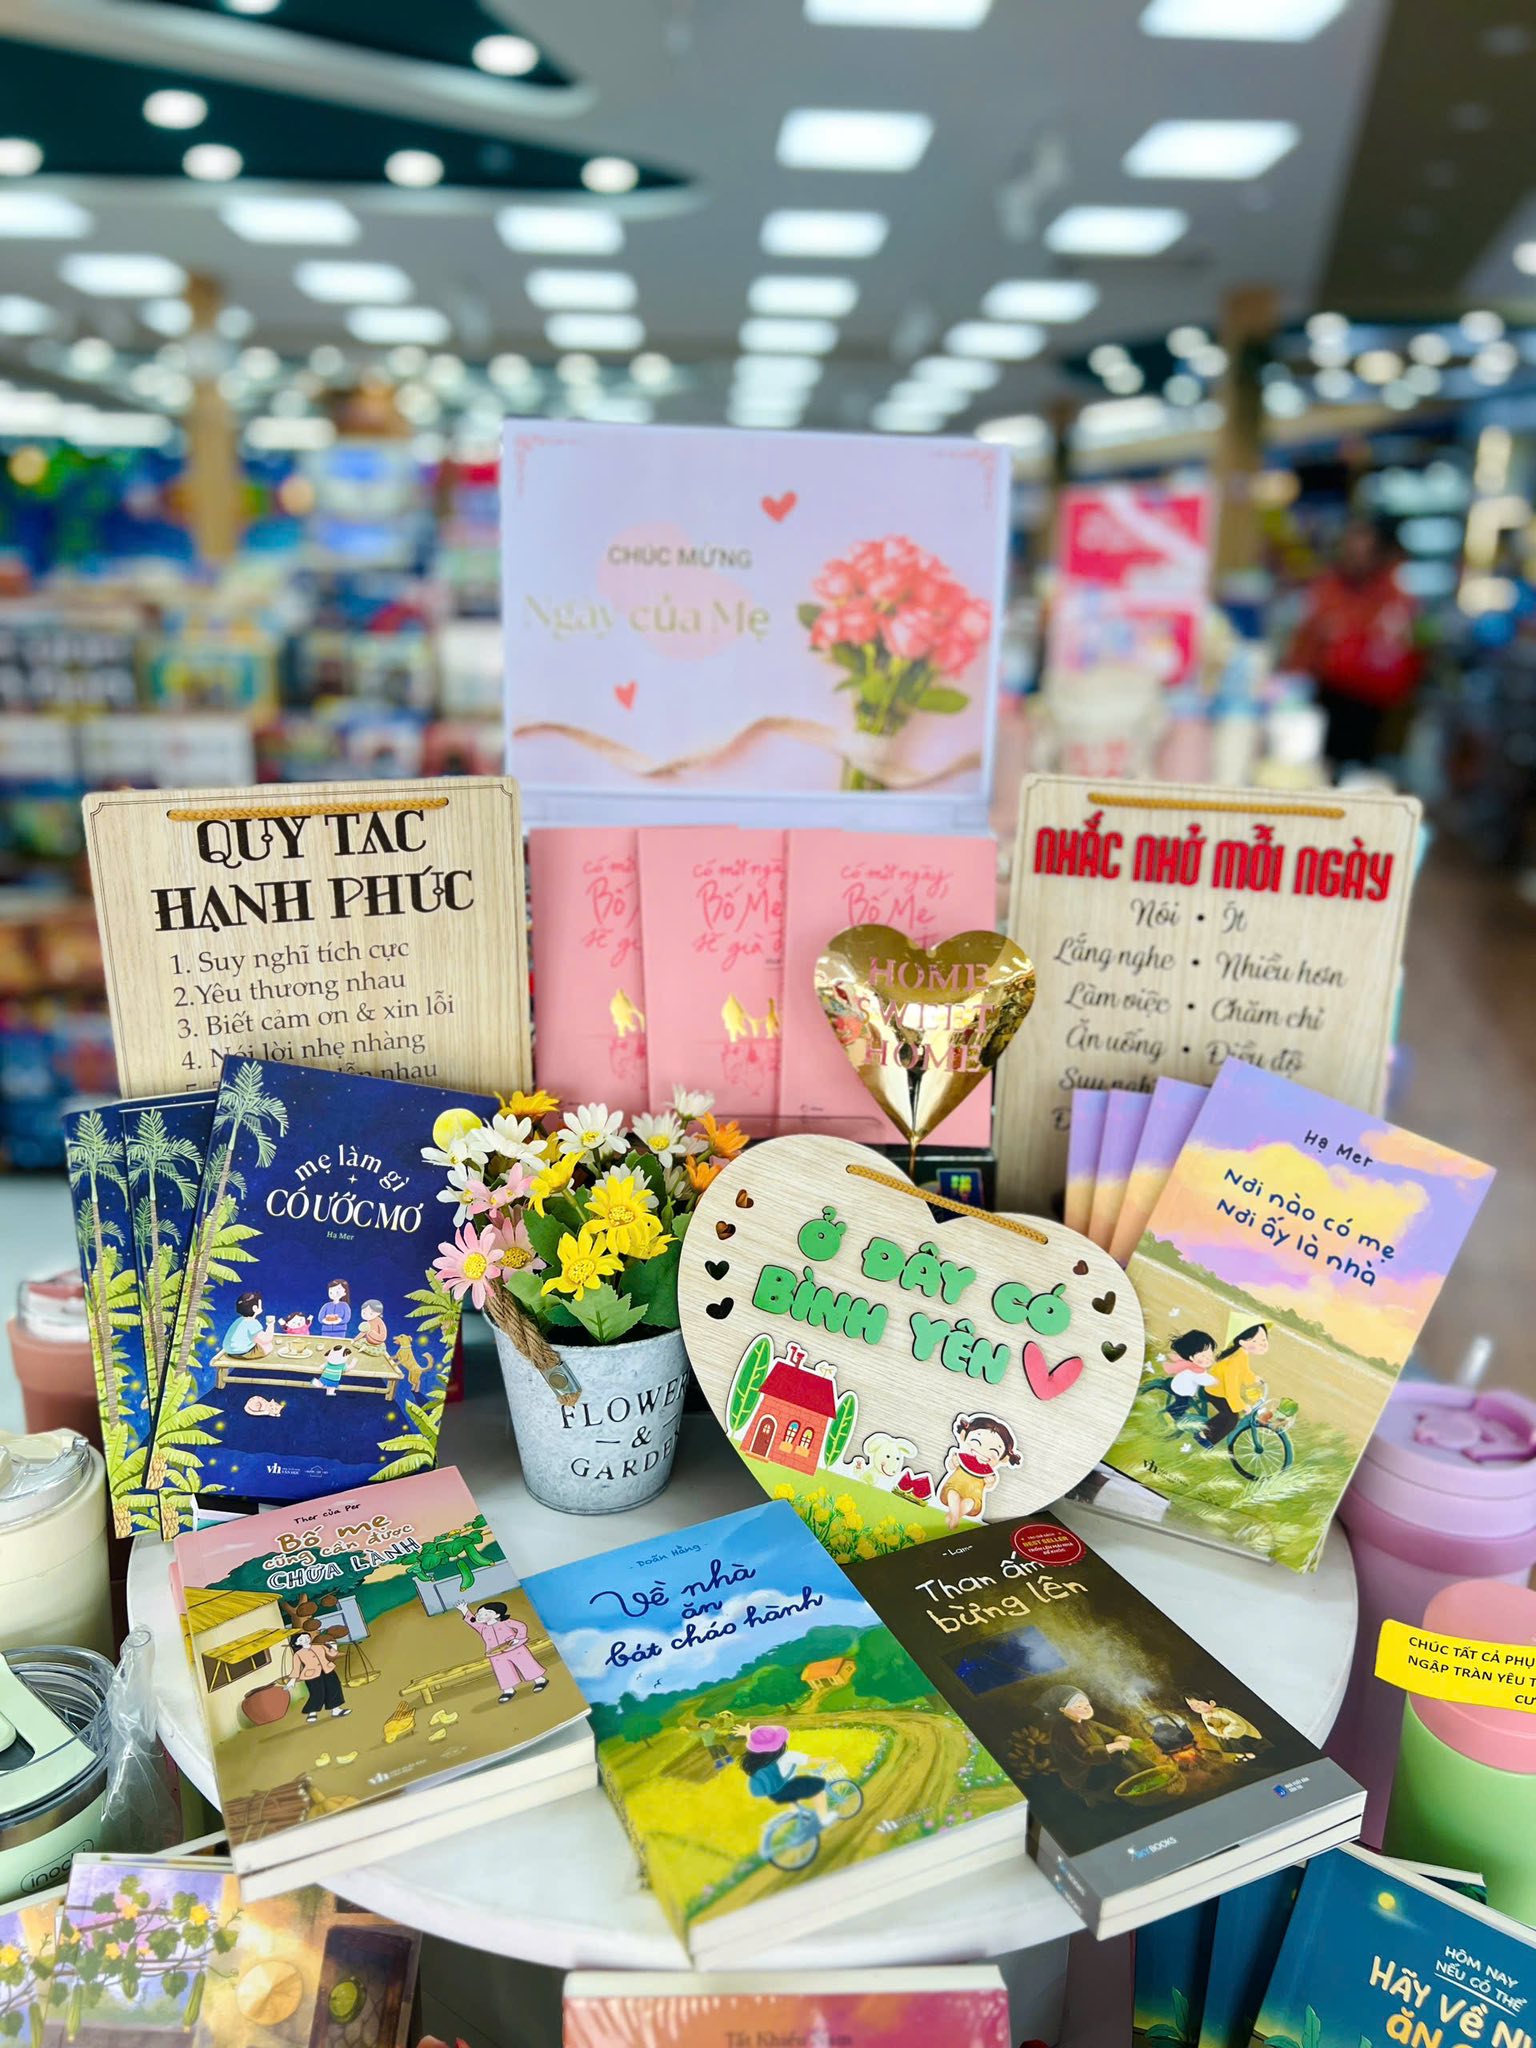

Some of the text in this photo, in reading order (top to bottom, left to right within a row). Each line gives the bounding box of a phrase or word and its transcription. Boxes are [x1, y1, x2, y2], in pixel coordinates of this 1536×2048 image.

[196, 816, 311, 869] QUY
[1033, 811, 1394, 903] NHẮC NHỞ MỖI NGÀY
[150, 879, 315, 933] HẠNH
[1130, 898, 1180, 927] Nói
[170, 940, 410, 977] 1. Suy nghĩ tích cực
[867, 955, 991, 993] HOME
[1117, 946, 1176, 976] nghe
[249, 979, 340, 1001] thương
[345, 970, 407, 993] nhau
[176, 989, 456, 1039] 3. Biết cảm ơn & xin lỗi
[263, 1042, 295, 1062] lời
[301, 1037, 346, 1060] nhẹ
[351, 1031, 426, 1055] nhàng
[864, 1037, 983, 1073] HOME
[294, 1143, 410, 1192] mẹ làm gì
[1303, 1129, 1375, 1168] Hạ Mer
[265, 1184, 424, 1233] CÓ ƯỚC MƠ
[1223, 1167, 1396, 1264] Nơi nào có mẹ
[1216, 1198, 1378, 1288] Nơi ấy là nhà
[797, 1205, 1071, 1336] Ở ĐÂY CÓ
[751, 1263, 1012, 1385] BÌNH YÊN
[631, 1425, 652, 1449] &
[275, 1514, 391, 1553] Bố mẹ
[294, 1502, 361, 1525] Ther của Per
[263, 1523, 415, 1570] cũng cần được
[267, 1537, 422, 1590] CHỮA LÀNH
[635, 1551, 667, 1569] Doãn
[589, 1558, 757, 1618] Về nhà
[915, 1550, 1046, 1603] Than ấm
[1026, 1575, 1089, 1604] lên
[605, 1585, 824, 1668] bát cháo hành
[681, 1600, 723, 1620] ăn
[1407, 1655, 1450, 1674] NGẬP
[1453, 1666, 1493, 1682] TRÀN
[1497, 1672, 1526, 1686] YÊU
[1408, 1636, 1536, 1670] CHÚC TẤT CẢ PHỤ
[1368, 1954, 1432, 2009] HÃY
[1435, 1959, 1529, 2014] NẾU CÓ THỂ
[1444, 1944, 1519, 1989] HÔM NAY
